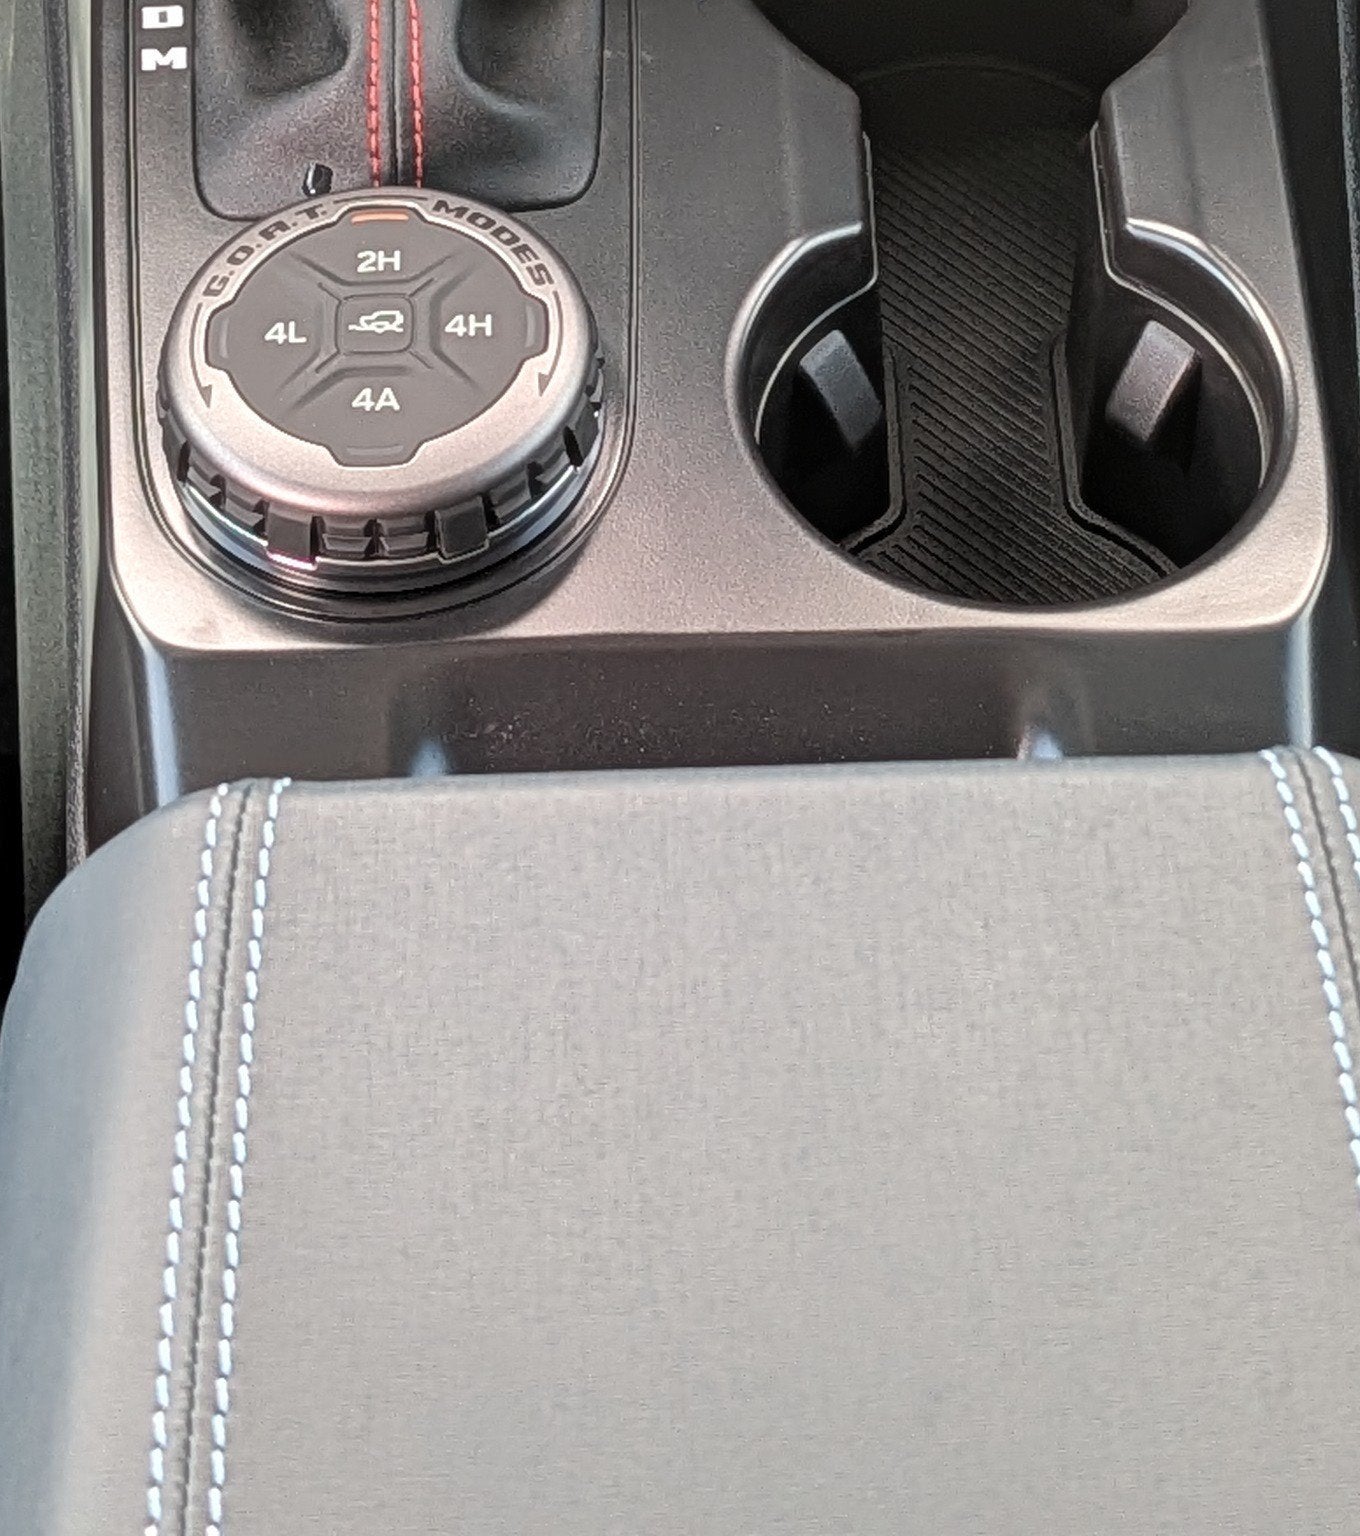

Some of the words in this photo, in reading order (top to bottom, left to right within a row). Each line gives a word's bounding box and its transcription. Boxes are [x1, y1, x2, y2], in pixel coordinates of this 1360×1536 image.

[141, 5, 184, 29] D
[141, 47, 188, 71] M
[202, 201, 328, 298] G.O.A.T.
[431, 199, 555, 287] MODES
[355, 250, 402, 273] 2H
[263, 321, 308, 345] 4L
[443, 315, 494, 339] 4H
[350, 388, 401, 412] 4A
